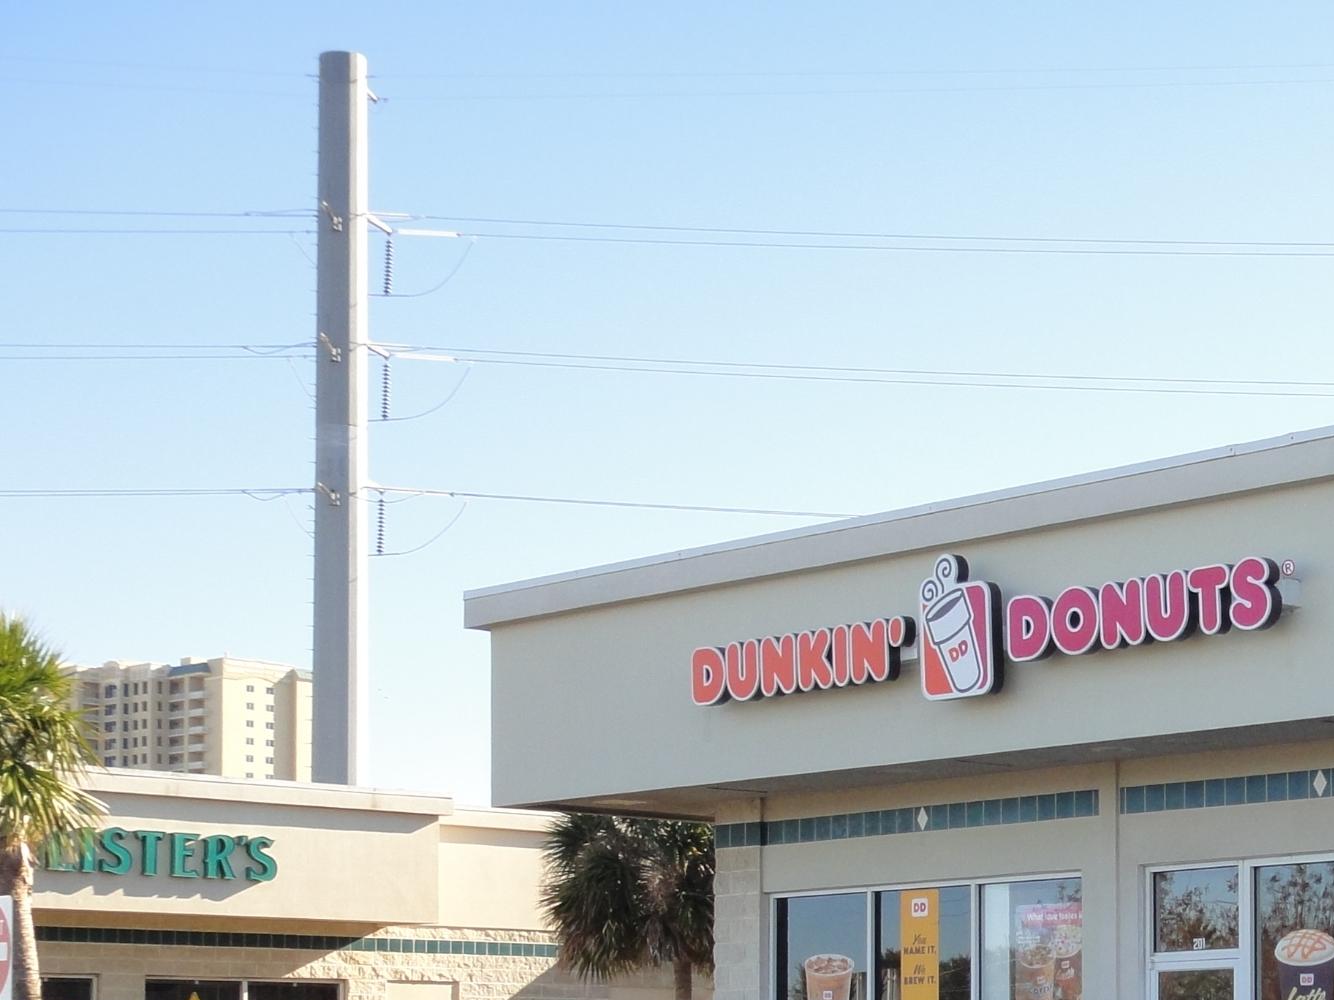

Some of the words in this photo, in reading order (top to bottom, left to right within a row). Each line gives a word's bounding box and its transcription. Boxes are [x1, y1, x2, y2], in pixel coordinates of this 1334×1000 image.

[692, 615, 904, 706] DUNKIN'
[1007, 556, 1271, 662] DONUTS
[949, 639, 969, 663] DD
[45, 826, 279, 882] LISTER'S
[913, 902, 927, 913] DD
[903, 946, 925, 955] NAME
